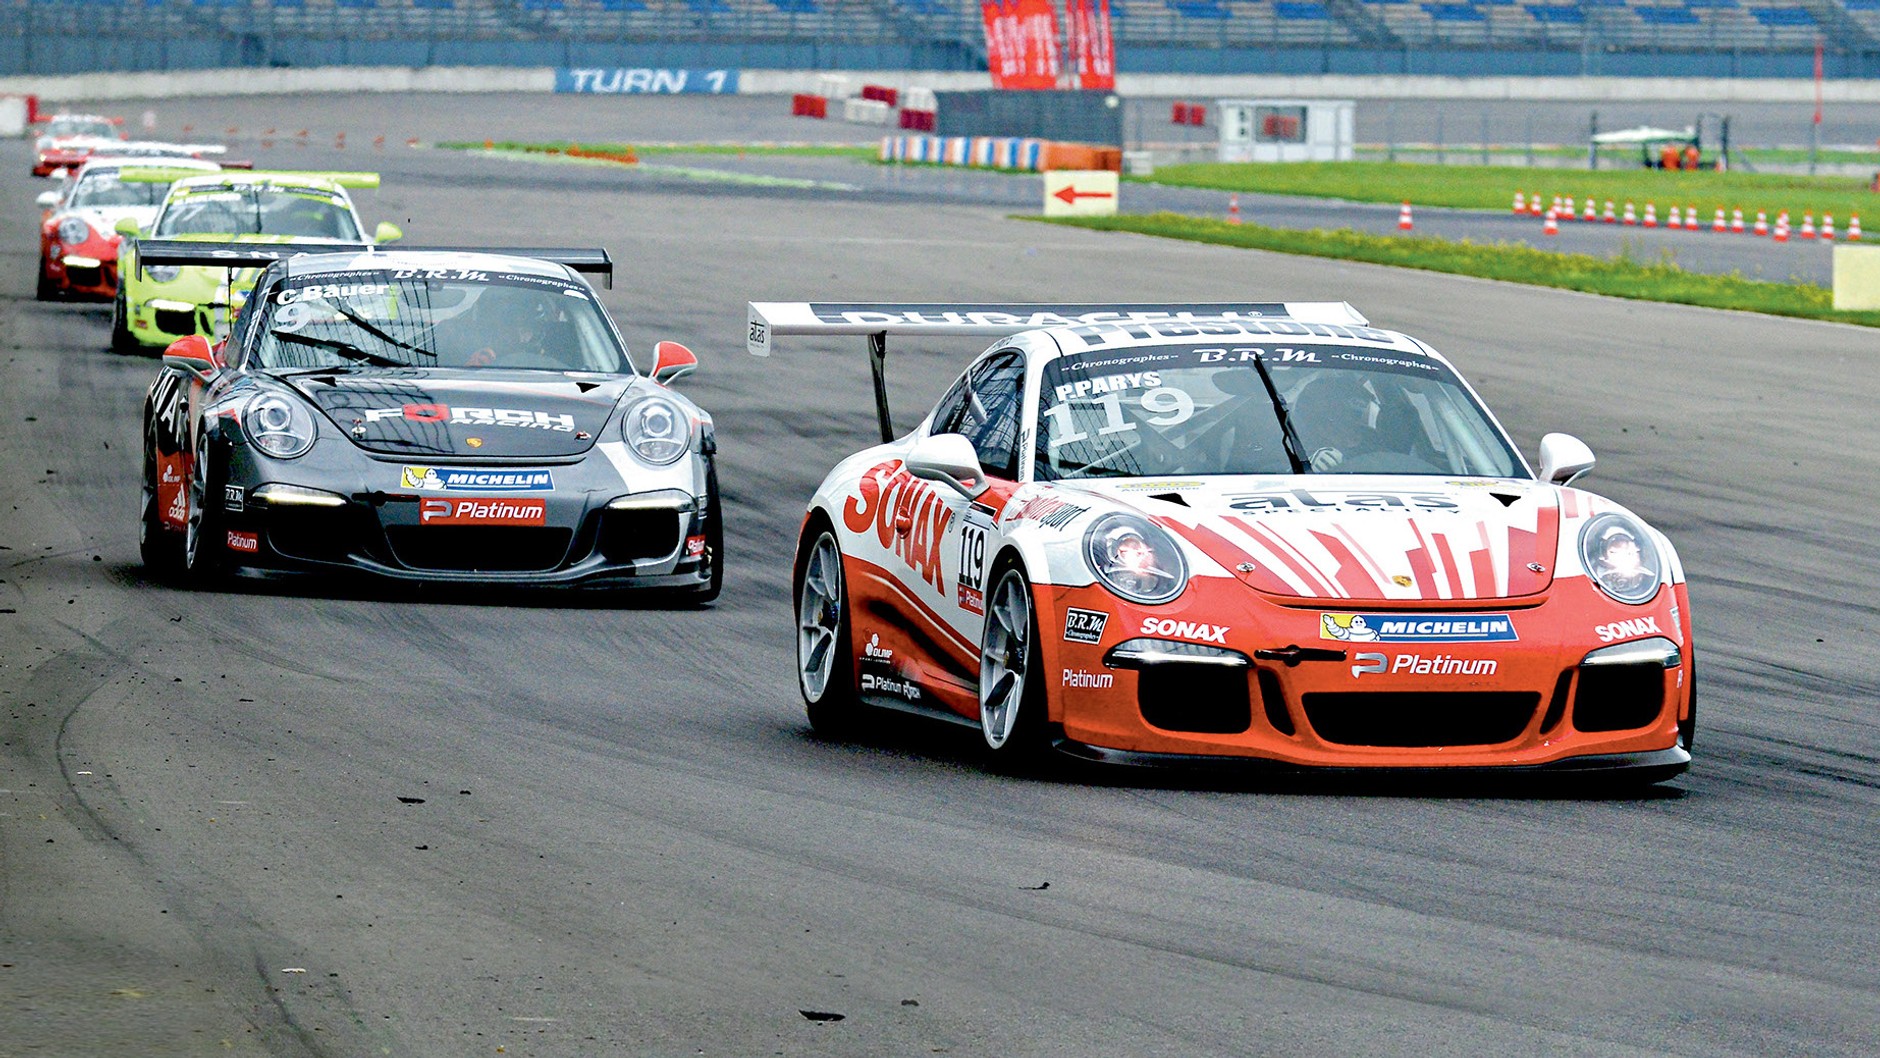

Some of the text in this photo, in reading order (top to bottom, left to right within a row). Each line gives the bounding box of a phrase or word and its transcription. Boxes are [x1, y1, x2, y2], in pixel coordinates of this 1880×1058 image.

[570, 68, 728, 93] TURN 1
[274, 302, 312, 333] 9
[1069, 320, 1395, 346] Prestone
[1192, 348, 1322, 364] B.R.M
[1055, 371, 1163, 402] P.PARYS
[1043, 387, 1195, 448] 119
[447, 473, 549, 486] MICHELIN
[455, 502, 543, 519] Platinum
[227, 531, 258, 549] Platinum
[843, 458, 954, 599] SONAX
[958, 525, 985, 590] 119
[1067, 612, 1104, 632] B.R.M
[1139, 617, 1231, 644] SONAX
[1379, 621, 1508, 634] MICHELIN
[1594, 616, 1663, 643] SONAX
[1391, 654, 1498, 675] Platinum
[875, 676, 902, 694] Platinum
[1062, 669, 1114, 688] Platinum
